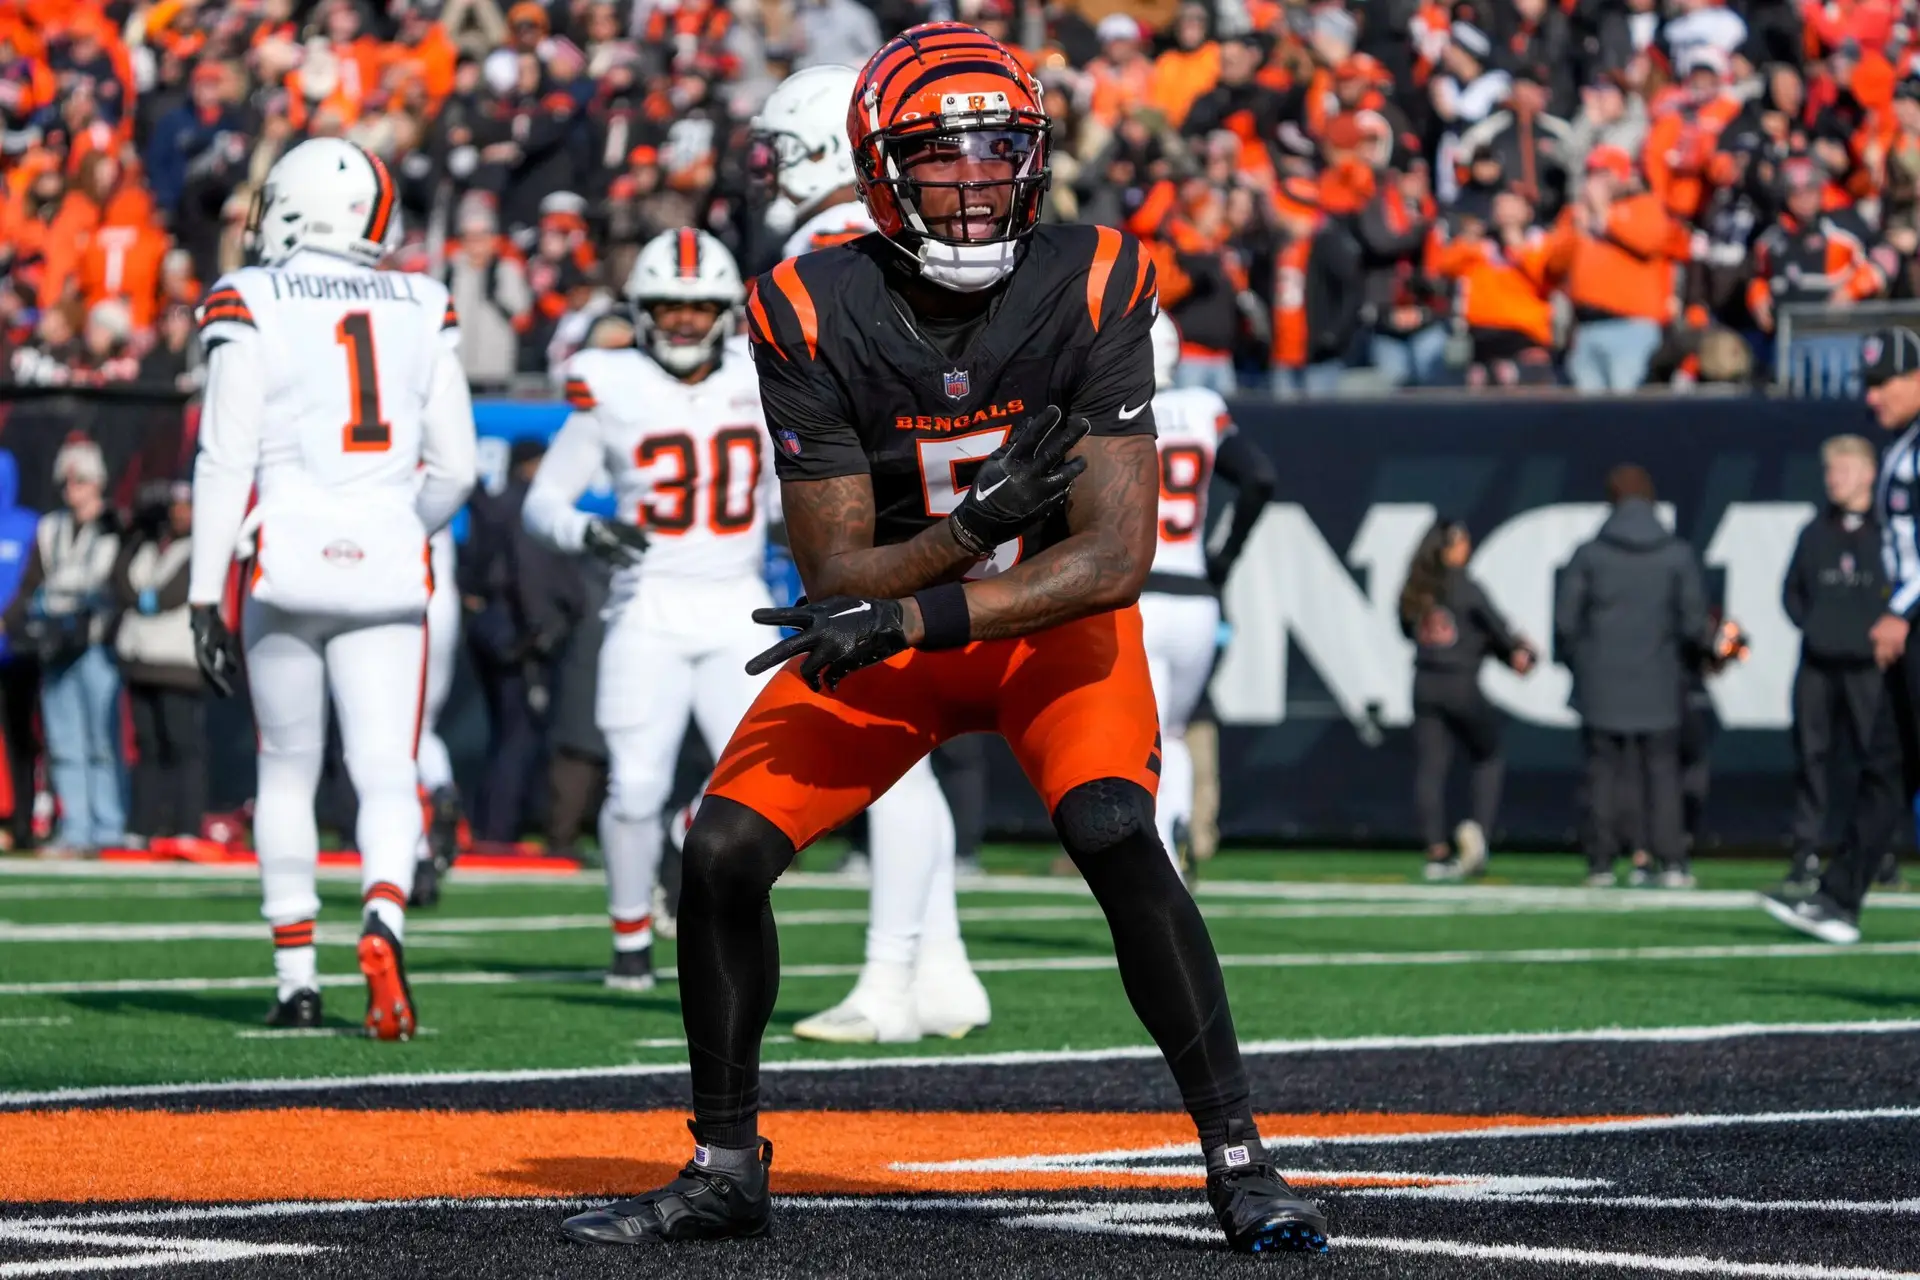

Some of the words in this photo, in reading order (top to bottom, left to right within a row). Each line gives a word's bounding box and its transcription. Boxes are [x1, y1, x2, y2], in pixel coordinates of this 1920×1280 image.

[269, 271, 422, 306] THORNHILL
[334, 310, 392, 453] 1
[895, 399, 1025, 432] BENGALS
[634, 424, 763, 536] 30
[1158, 441, 1214, 542] 9
